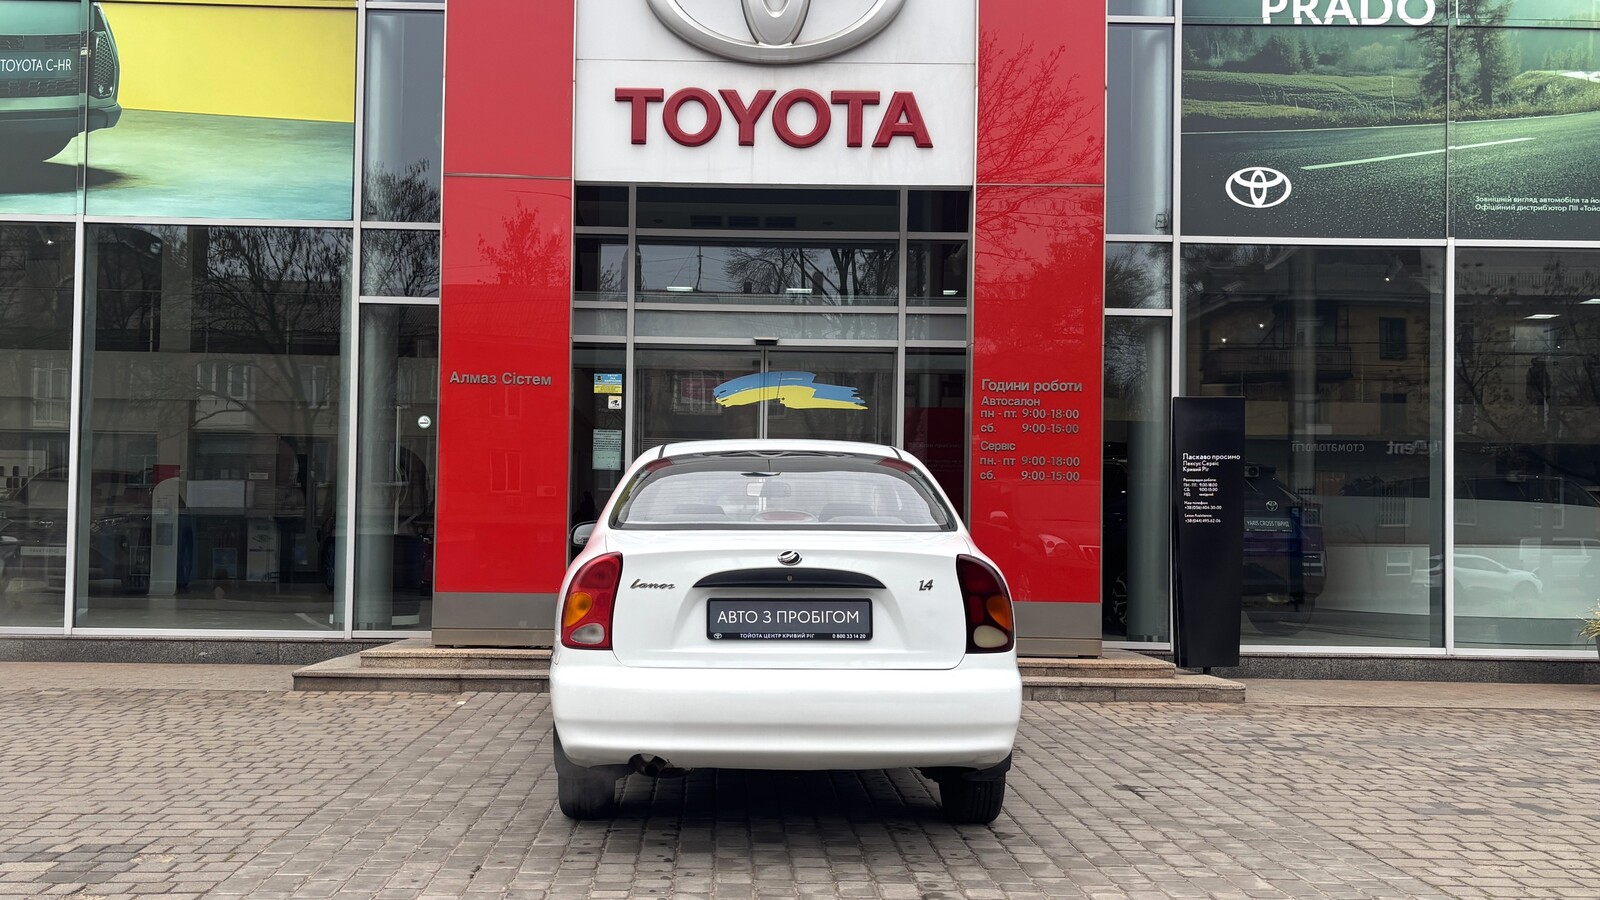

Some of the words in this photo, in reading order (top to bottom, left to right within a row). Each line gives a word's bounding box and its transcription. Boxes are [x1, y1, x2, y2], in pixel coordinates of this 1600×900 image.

[1261, 0, 1436, 25] PRADO
[0, 58, 44, 72] TOYOTA
[45, 58, 72, 72] C-HR
[614, 86, 934, 148] TOYOTA
[1539, 196, 1580, 204] автомобіля
[449, 371, 497, 384] Алмаз
[501, 372, 553, 386] Сістем
[981, 378, 1030, 393] Години
[1033, 380, 1083, 395] роботи
[980, 396, 1041, 407] Автосалон
[1021, 408, 1080, 419] 9:00-18:00
[980, 423, 997, 433] сб.
[1021, 423, 1080, 434] 9:00-15:00
[980, 440, 1017, 453] Сервіс
[1021, 456, 1081, 467] 9:00-18:00
[1182, 452, 1212, 460] Ласкаво
[979, 470, 997, 480] сб.
[1021, 470, 1081, 481] 9:00-15:00
[717, 610, 758, 624] АВТО
[776, 610, 860, 624] ПРОБІГОМ
[763, 632, 782, 640] ЦЕНТР
